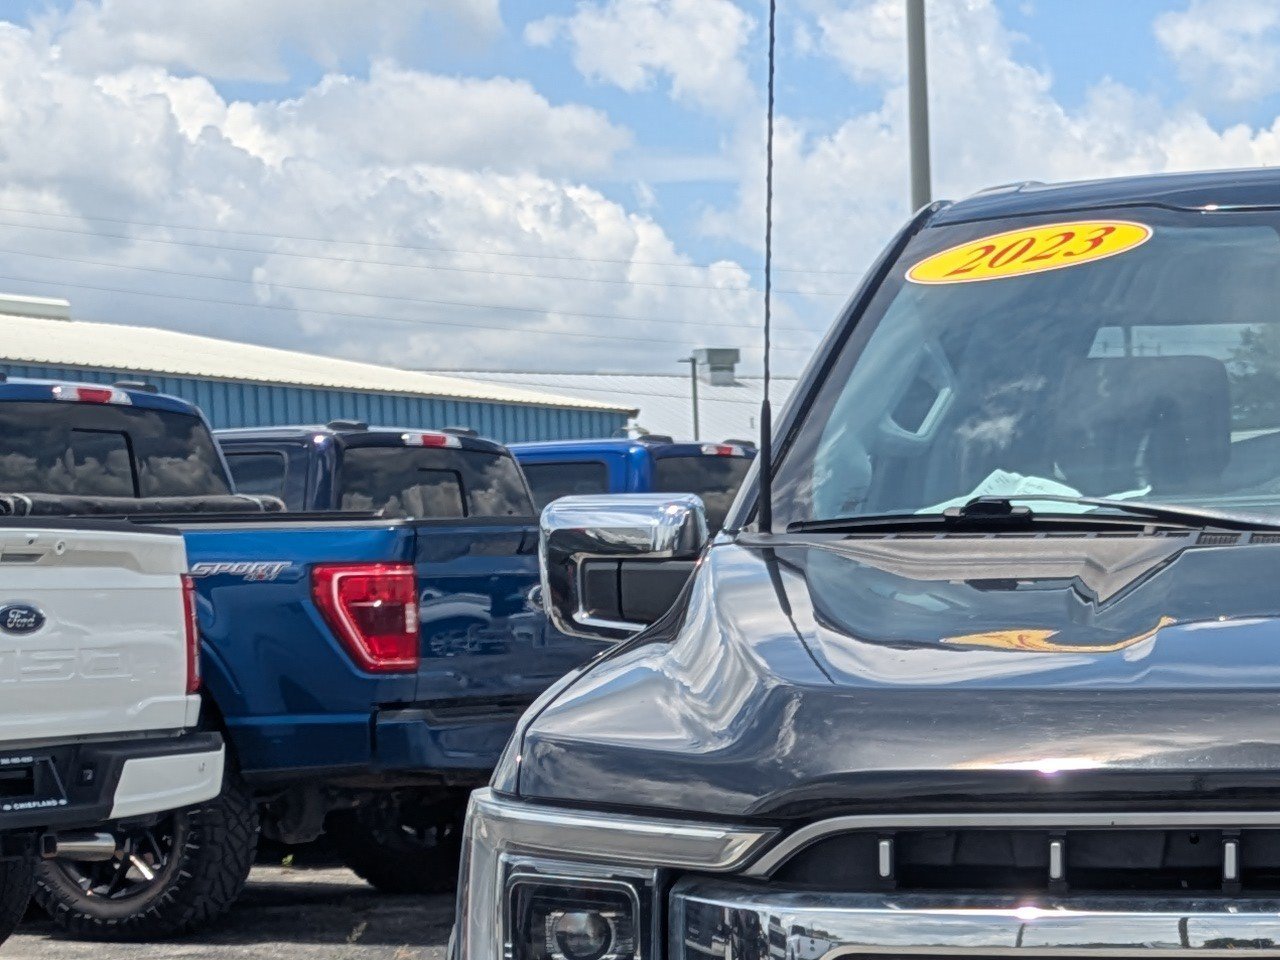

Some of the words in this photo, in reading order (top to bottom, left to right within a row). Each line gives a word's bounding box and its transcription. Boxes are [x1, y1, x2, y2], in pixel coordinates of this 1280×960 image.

[943, 226, 1116, 278] 2023
[189, 561, 293, 577] SPORT
[6, 608, 36, 629] Ford
